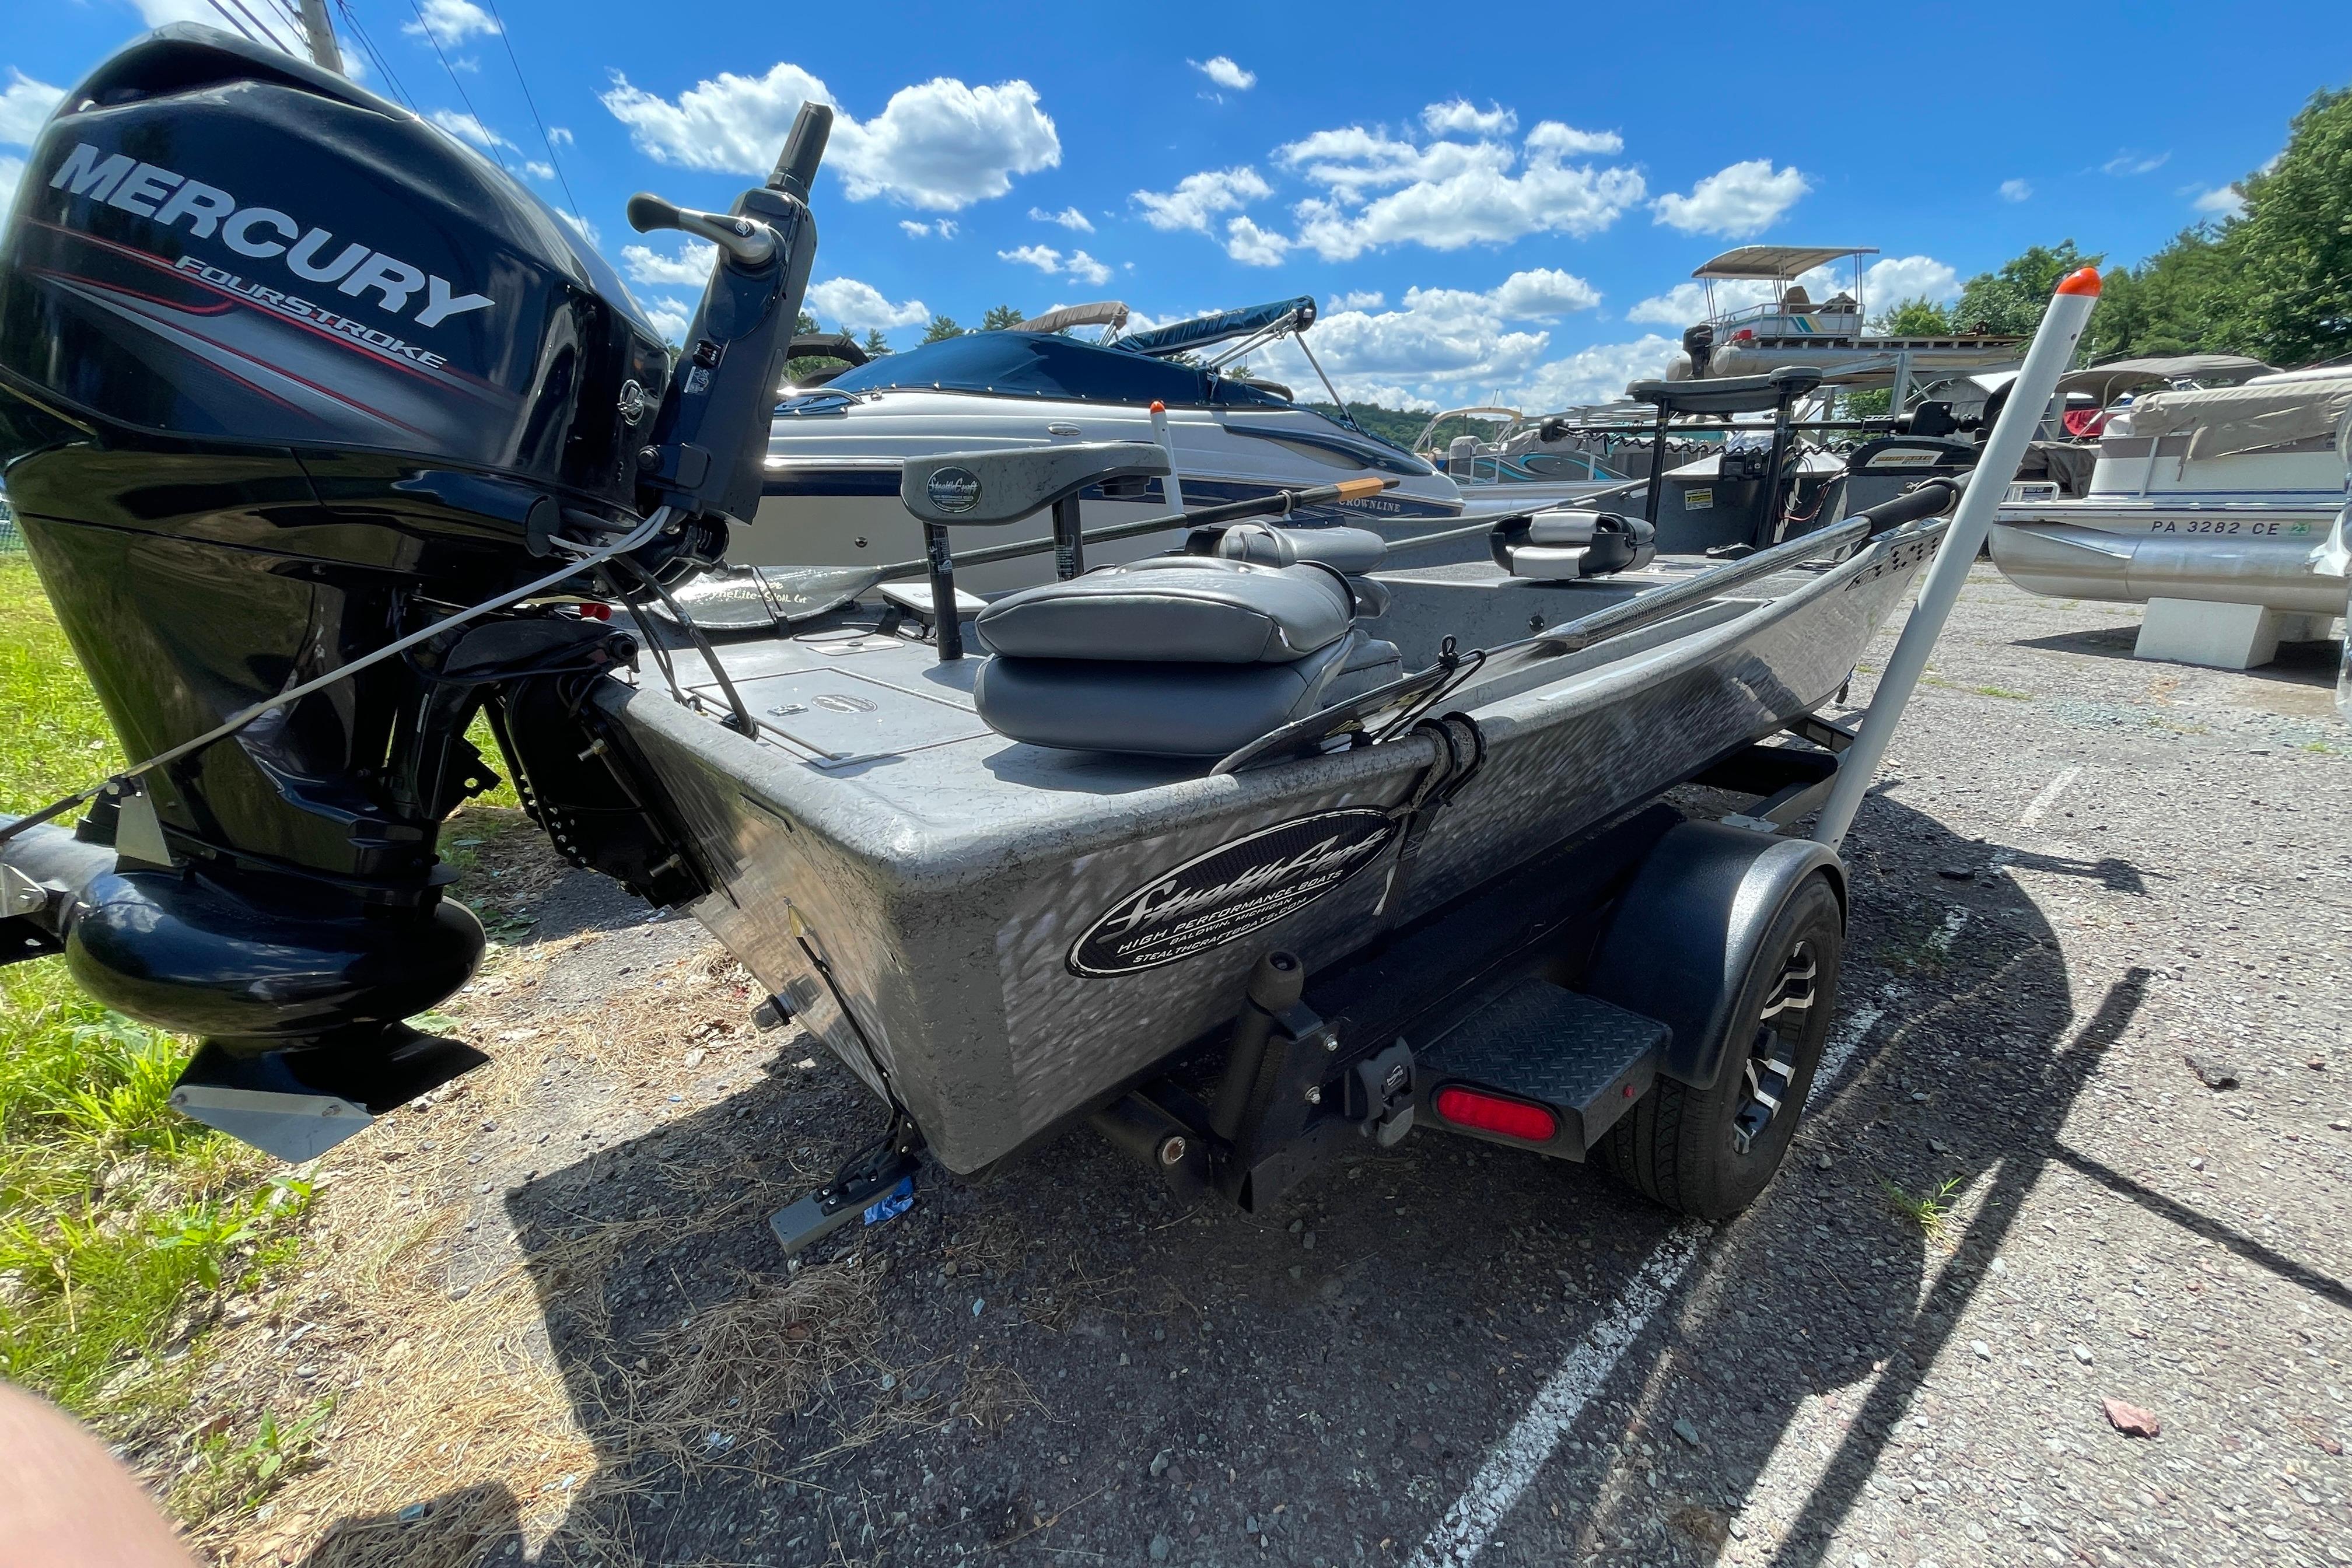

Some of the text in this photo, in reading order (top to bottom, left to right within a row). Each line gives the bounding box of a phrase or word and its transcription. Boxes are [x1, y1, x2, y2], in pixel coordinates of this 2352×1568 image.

[48, 142, 496, 329] MERCURY
[174, 255, 448, 369] FOURSTROKE
[2151, 521, 2280, 535] PA 3282 CE
[1116, 870, 1343, 954] HIGH PERFORMANCE BOATS
[1133, 896, 1307, 963] STEALTHCRAFTBOATS.COM
[1235, 897, 1293, 922] MICHIGAN
